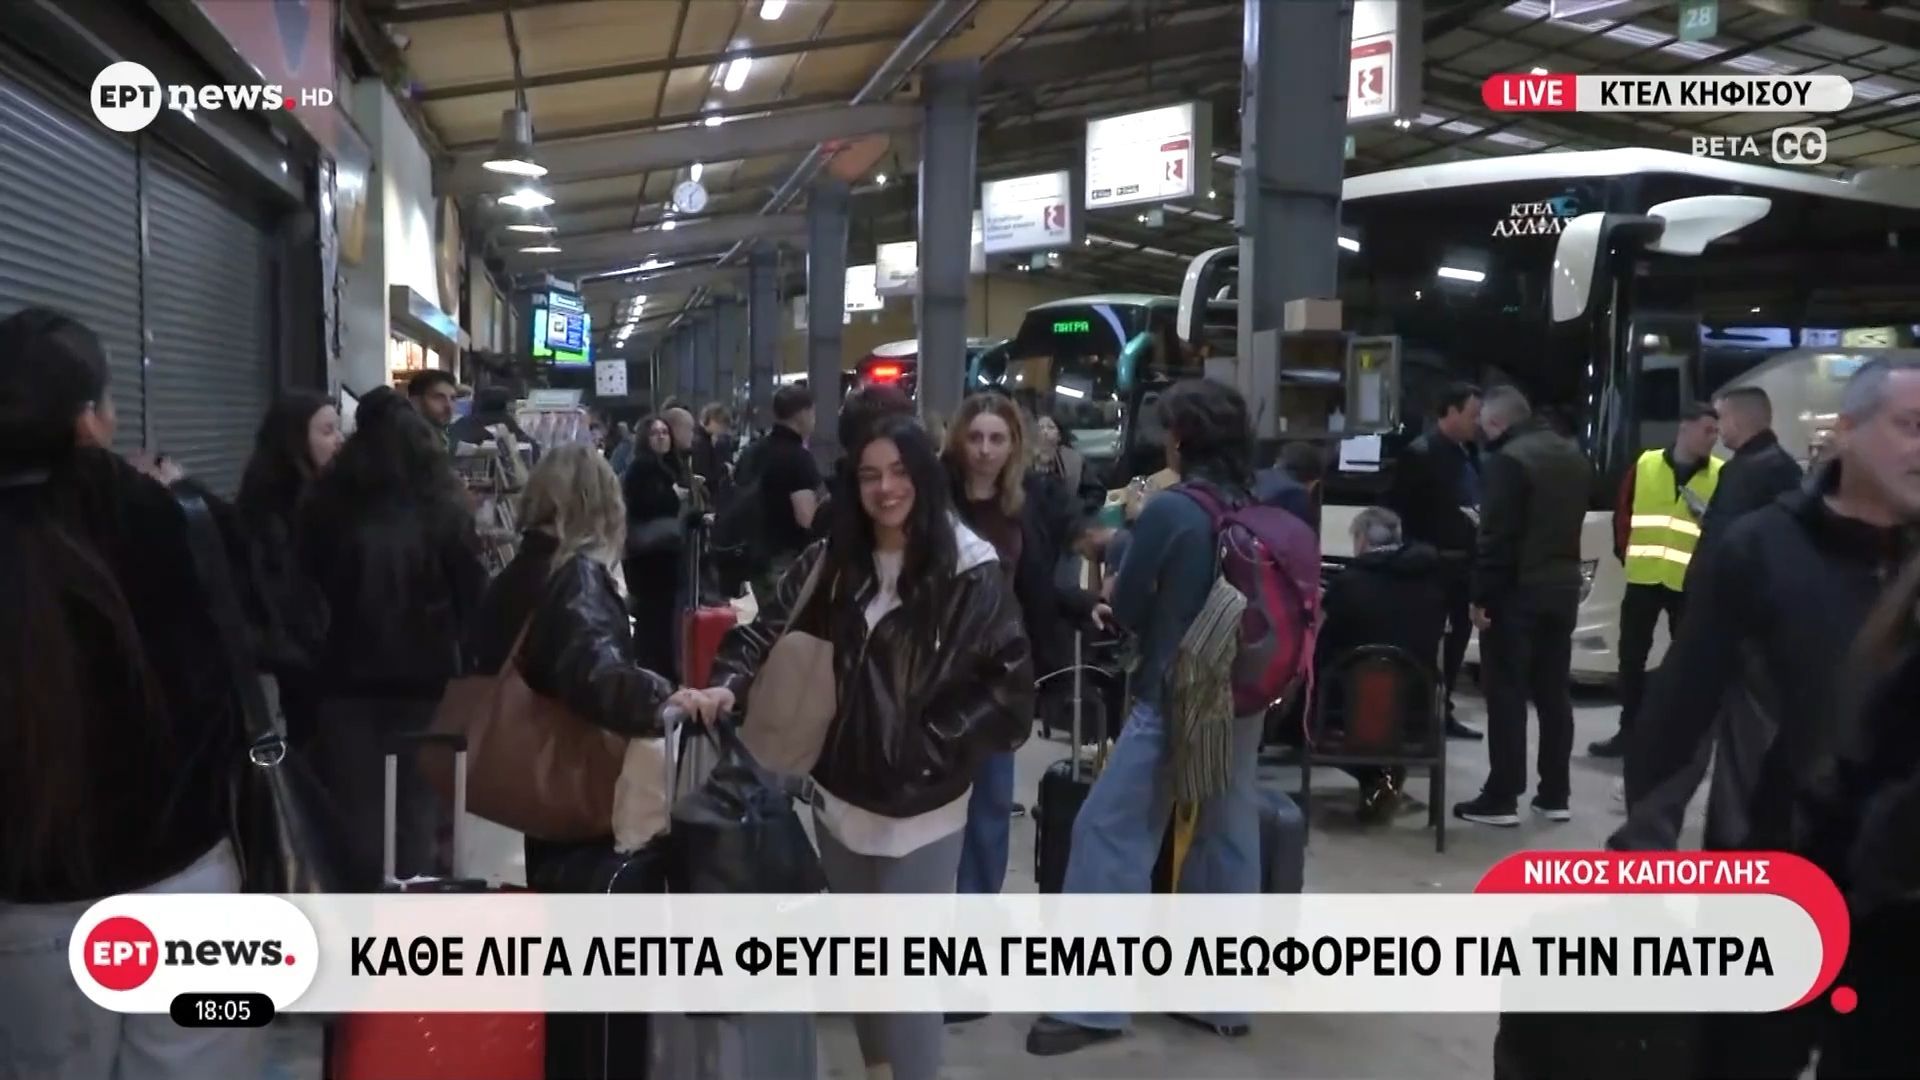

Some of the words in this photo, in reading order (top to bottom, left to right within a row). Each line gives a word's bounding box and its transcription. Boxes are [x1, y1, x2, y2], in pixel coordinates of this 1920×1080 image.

[1686, 6, 1711, 29] 28
[1510, 202, 1554, 217] ΚΤΕΛ
[1053, 320, 1090, 333] ΠΑΤΡΑ
